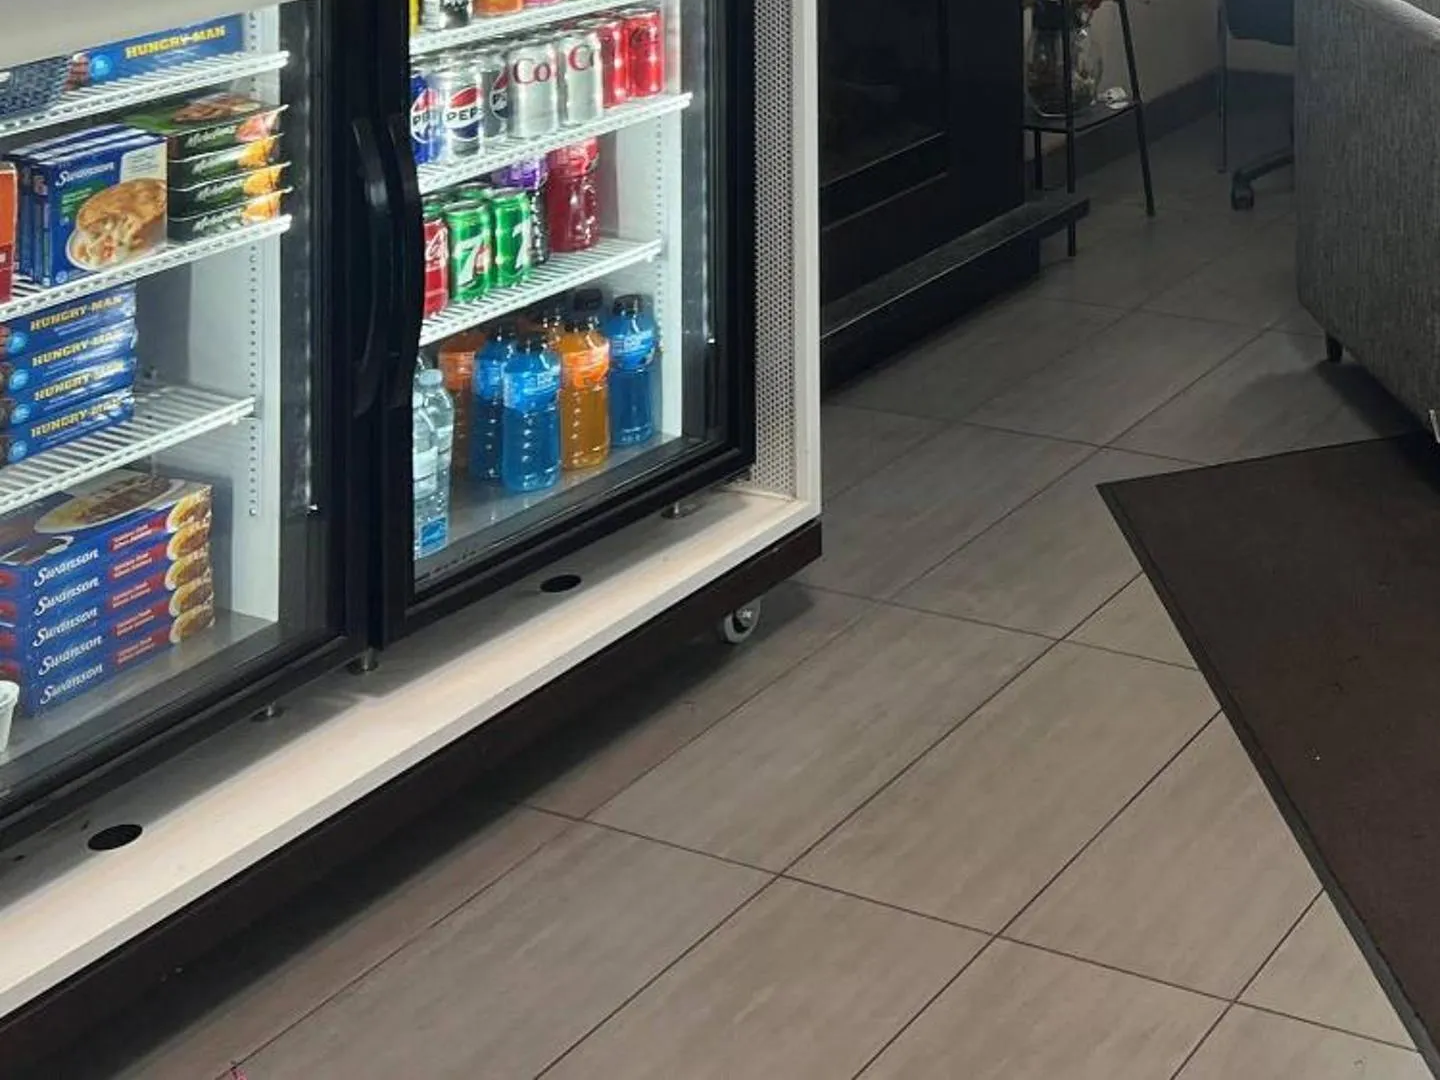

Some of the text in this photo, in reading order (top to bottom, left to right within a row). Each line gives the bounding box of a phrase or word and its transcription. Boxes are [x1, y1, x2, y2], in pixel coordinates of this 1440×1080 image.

[124, 24, 227, 59] HUNGRY-MAN
[33, 547, 99, 587] Swanson
[33, 576, 100, 616] Swanson
[32, 606, 98, 647] Swanson
[38, 635, 102, 676] Swanson
[40, 663, 103, 705] Swanson
